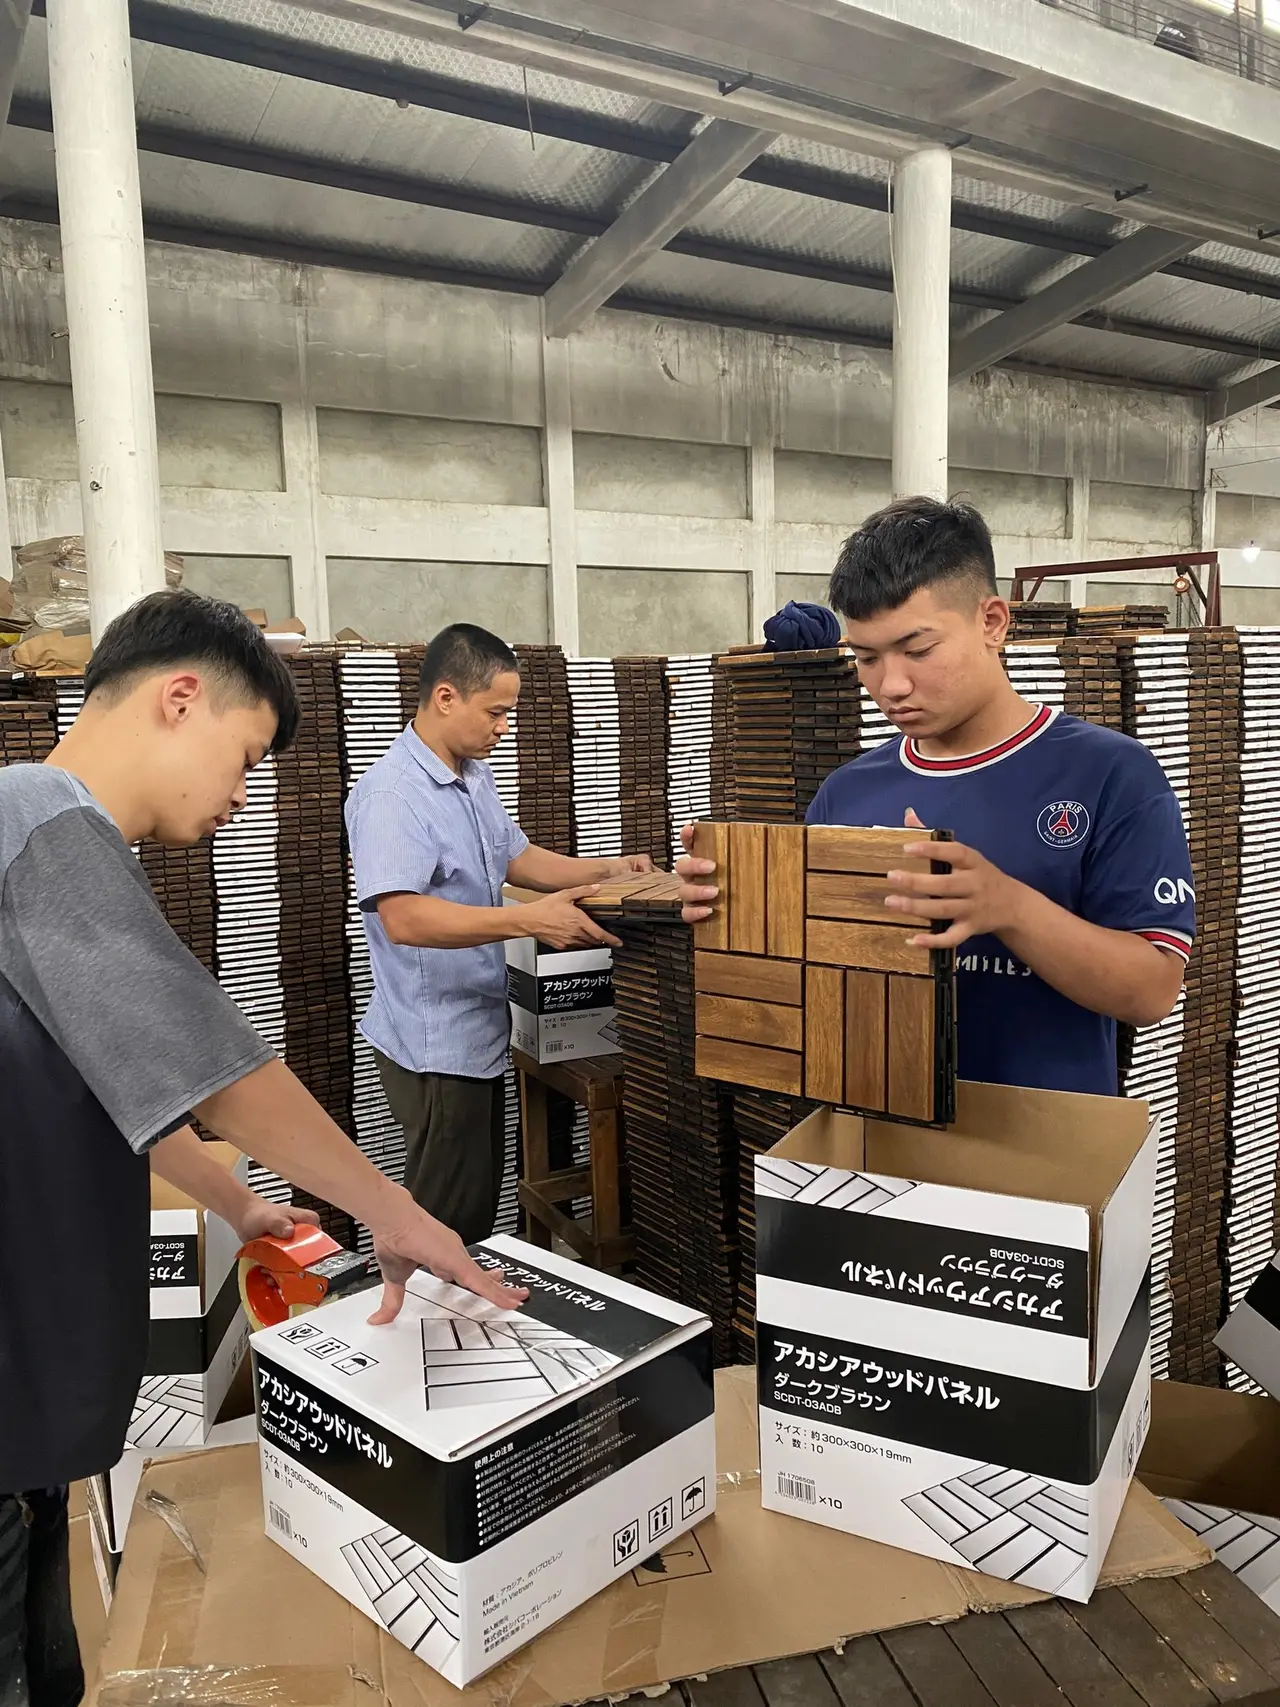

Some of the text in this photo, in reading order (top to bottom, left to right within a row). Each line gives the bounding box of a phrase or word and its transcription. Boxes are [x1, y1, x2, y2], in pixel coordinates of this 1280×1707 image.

[1049, 802, 1082, 814] PARIS
[543, 991, 594, 1004] ダークブラウン
[152, 1250, 185, 1262] ダーク
[939, 1254, 1065, 1290] ダークブラウン
[989, 1248, 1065, 1269] SCDT-03ADB
[472, 1251, 607, 1312] アカシアウッドパネル
[840, 1260, 1064, 1322] アカシアウッドパネル
[772, 1340, 1001, 1411] アカシアウッドパネル
[773, 1371, 893, 1412] ダークブラウン
[258, 1367, 393, 1469] アカシアウッドパネル
[773, 1390, 842, 1416] SCDT-03ADB
[260, 1399, 328, 1454] ダークブラウン
[261, 1417, 301, 1452] SCDT-03ADB
[818, 1495, 843, 1510] ×10
[482, 1580, 534, 1617] Made in Vietnam
